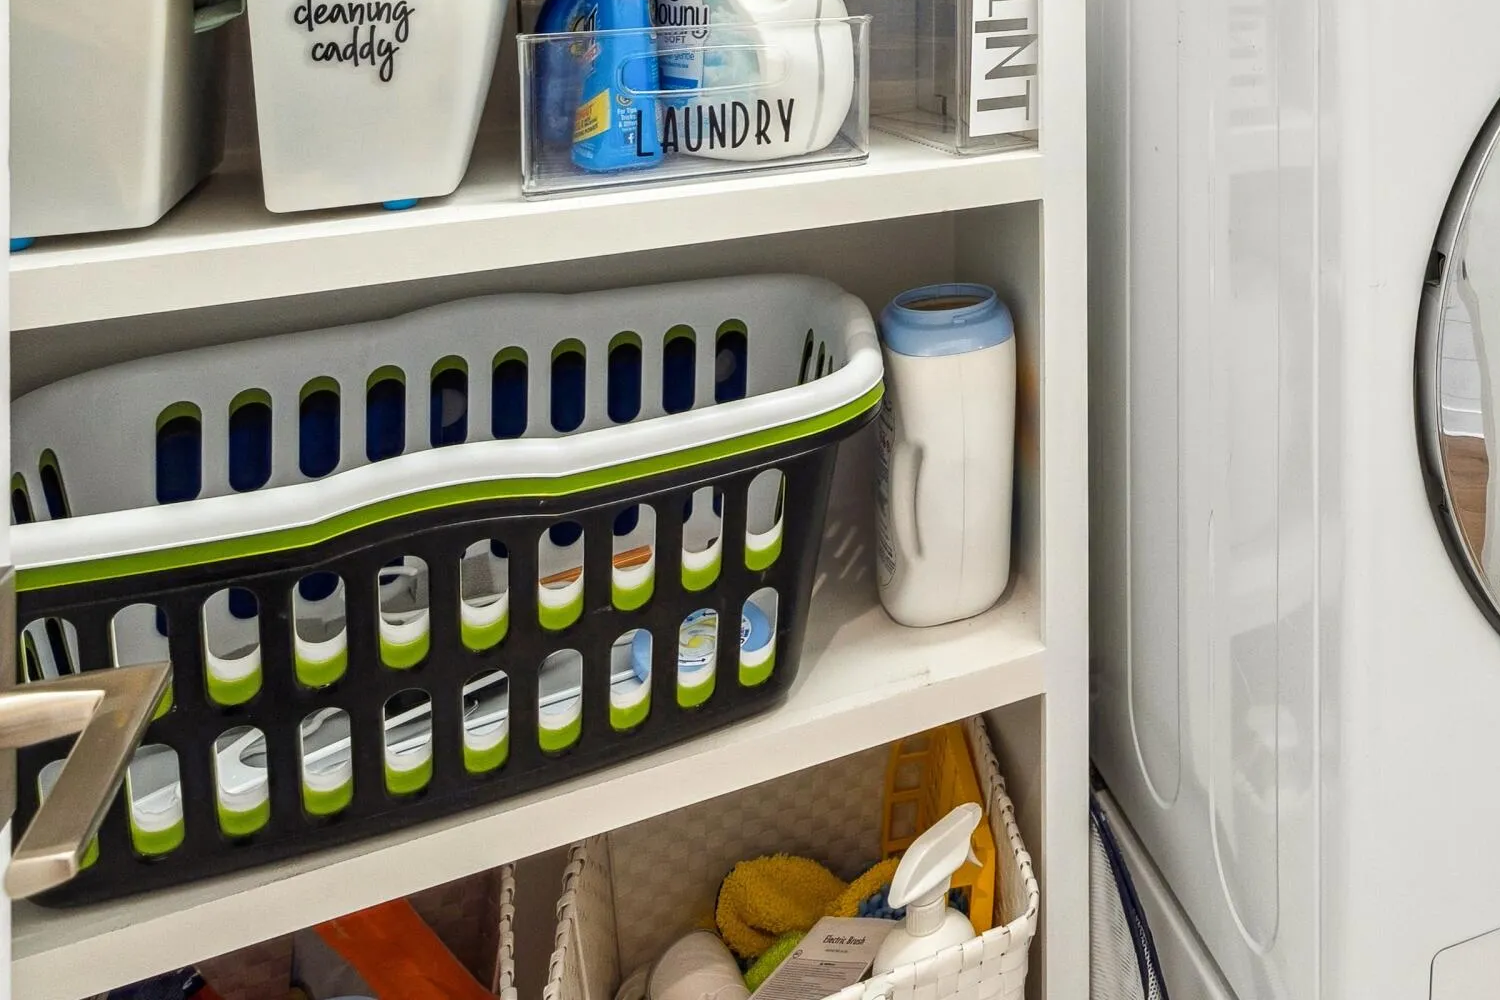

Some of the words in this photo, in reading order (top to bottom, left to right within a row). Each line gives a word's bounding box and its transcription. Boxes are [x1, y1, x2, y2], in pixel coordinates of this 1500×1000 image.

[311, 24, 400, 82] caddy
[636, 98, 795, 157] LAUNDRY
[822, 934, 846, 944] Electric
[846, 935, 866, 945] Brush
